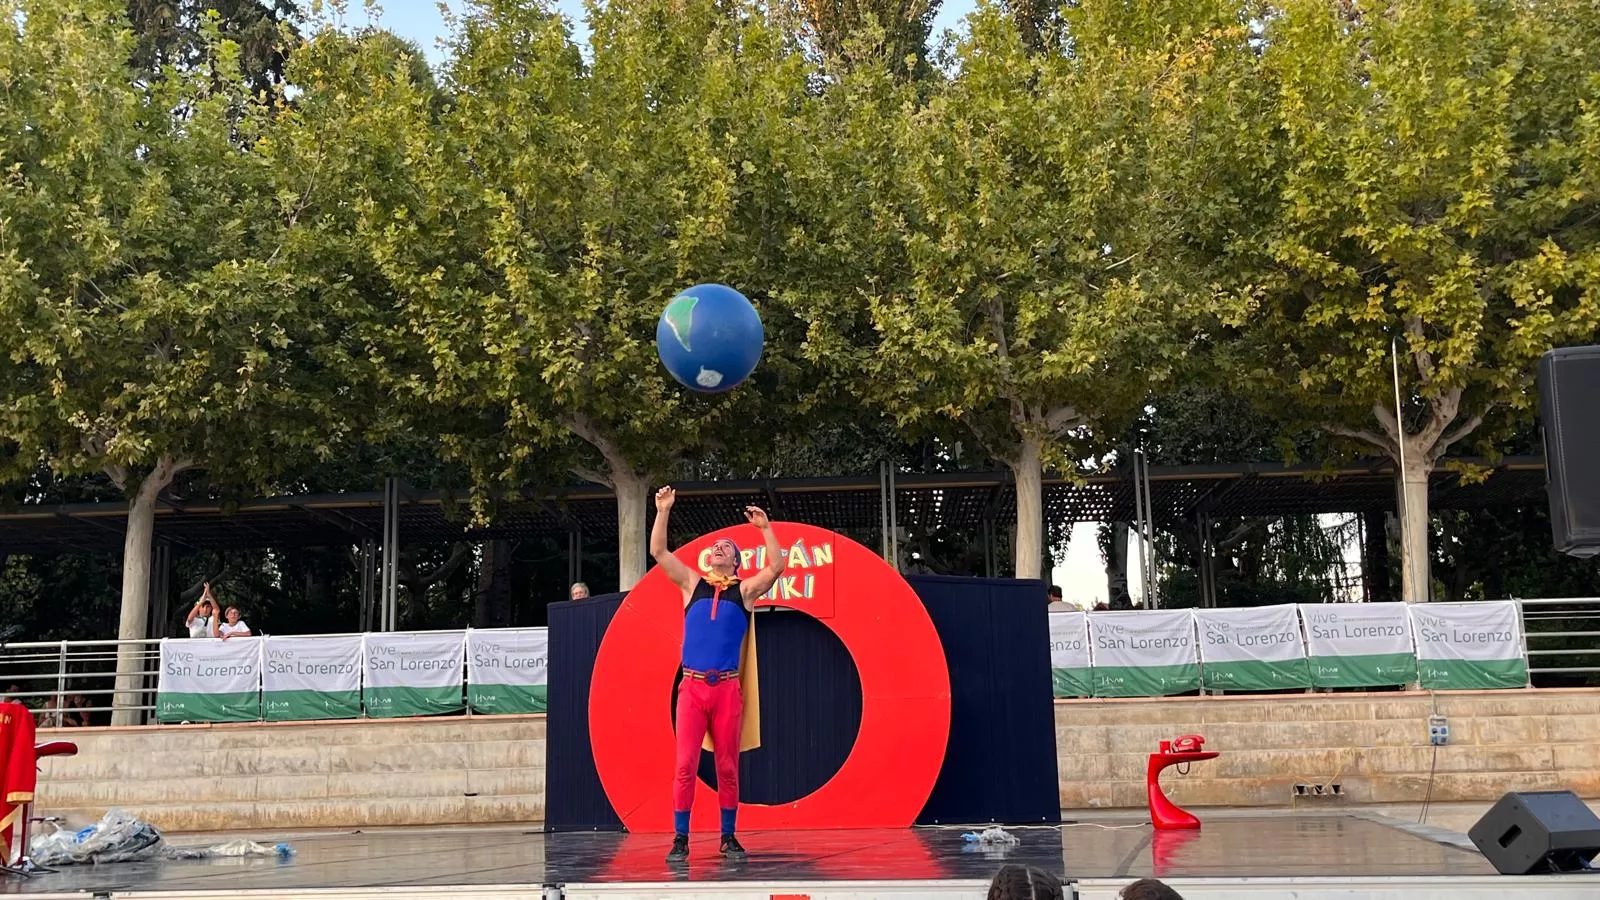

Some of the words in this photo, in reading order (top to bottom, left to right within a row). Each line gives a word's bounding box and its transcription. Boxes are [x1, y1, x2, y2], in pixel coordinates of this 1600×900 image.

[1236, 631, 1295, 647] Lorenzo
[1312, 625, 1340, 639] San
[1344, 624, 1404, 638] Lorenzo
[1453, 629, 1513, 643] Lorenzo
[1098, 636, 1126, 649] San
[1130, 636, 1188, 649] Lorenzo
[268, 660, 293, 674] San
[297, 661, 353, 675] Lorenzo
[370, 657, 395, 670] San
[400, 657, 456, 671] Lorenzo
[474, 654, 500, 668] San
[504, 655, 548, 669] Loren
[167, 662, 191, 676] San
[196, 664, 252, 677] Lorenzo
